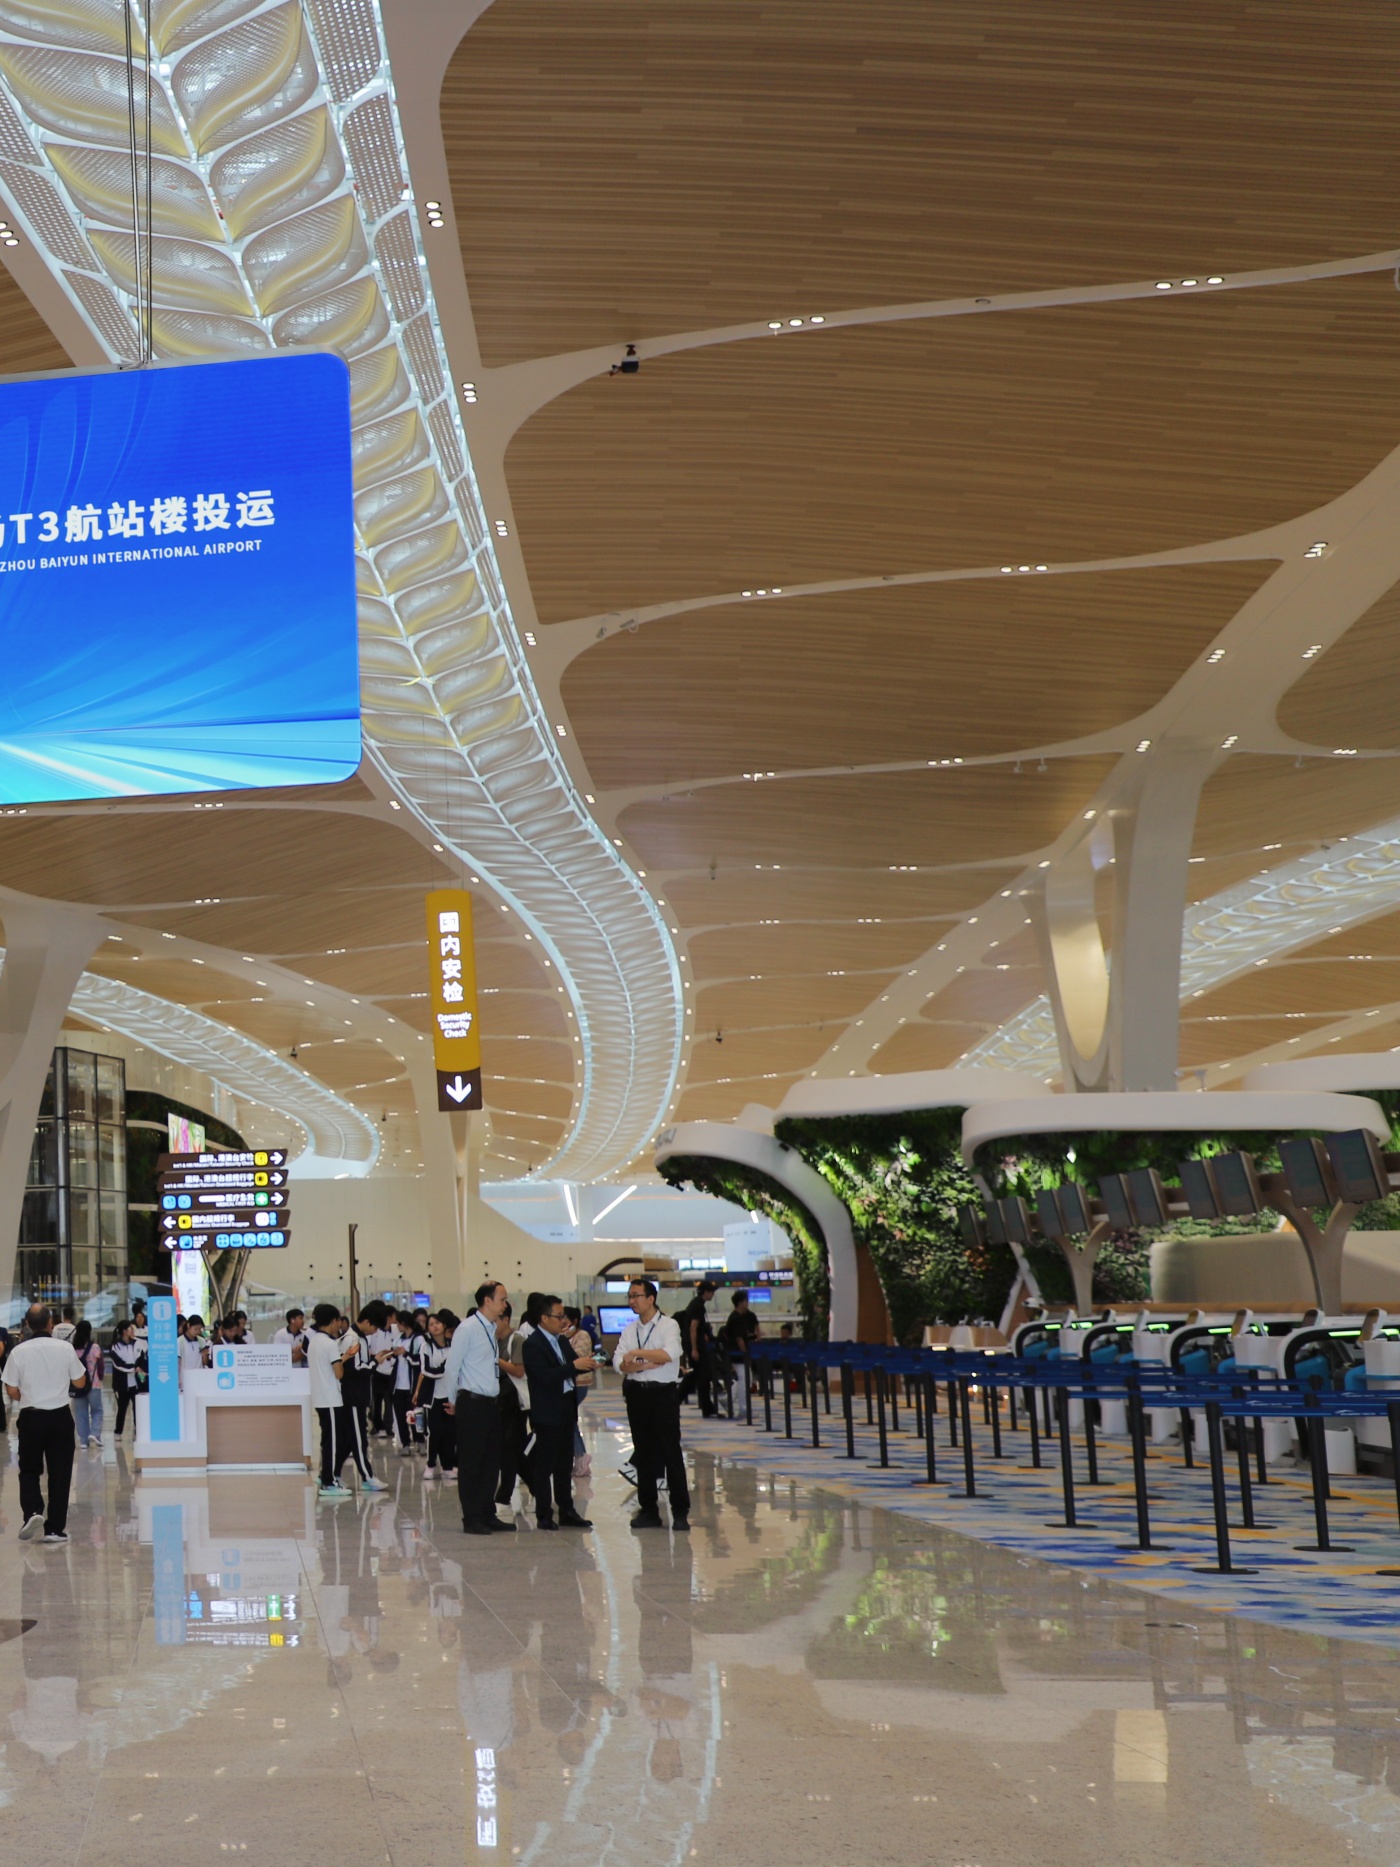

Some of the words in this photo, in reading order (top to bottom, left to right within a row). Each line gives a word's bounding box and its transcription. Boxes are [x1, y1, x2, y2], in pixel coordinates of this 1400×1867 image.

[40, 554, 88, 568] BAIYUN
[92, 545, 200, 564] INTERNATIONAL
[204, 540, 262, 555] AIRPORT
[438, 912, 464, 1002] 国内安检
[437, 1012, 472, 1022] Domestic
[440, 1021, 470, 1030] Security
[444, 1030, 466, 1038] Check
[151, 1342, 174, 1350] Weight
